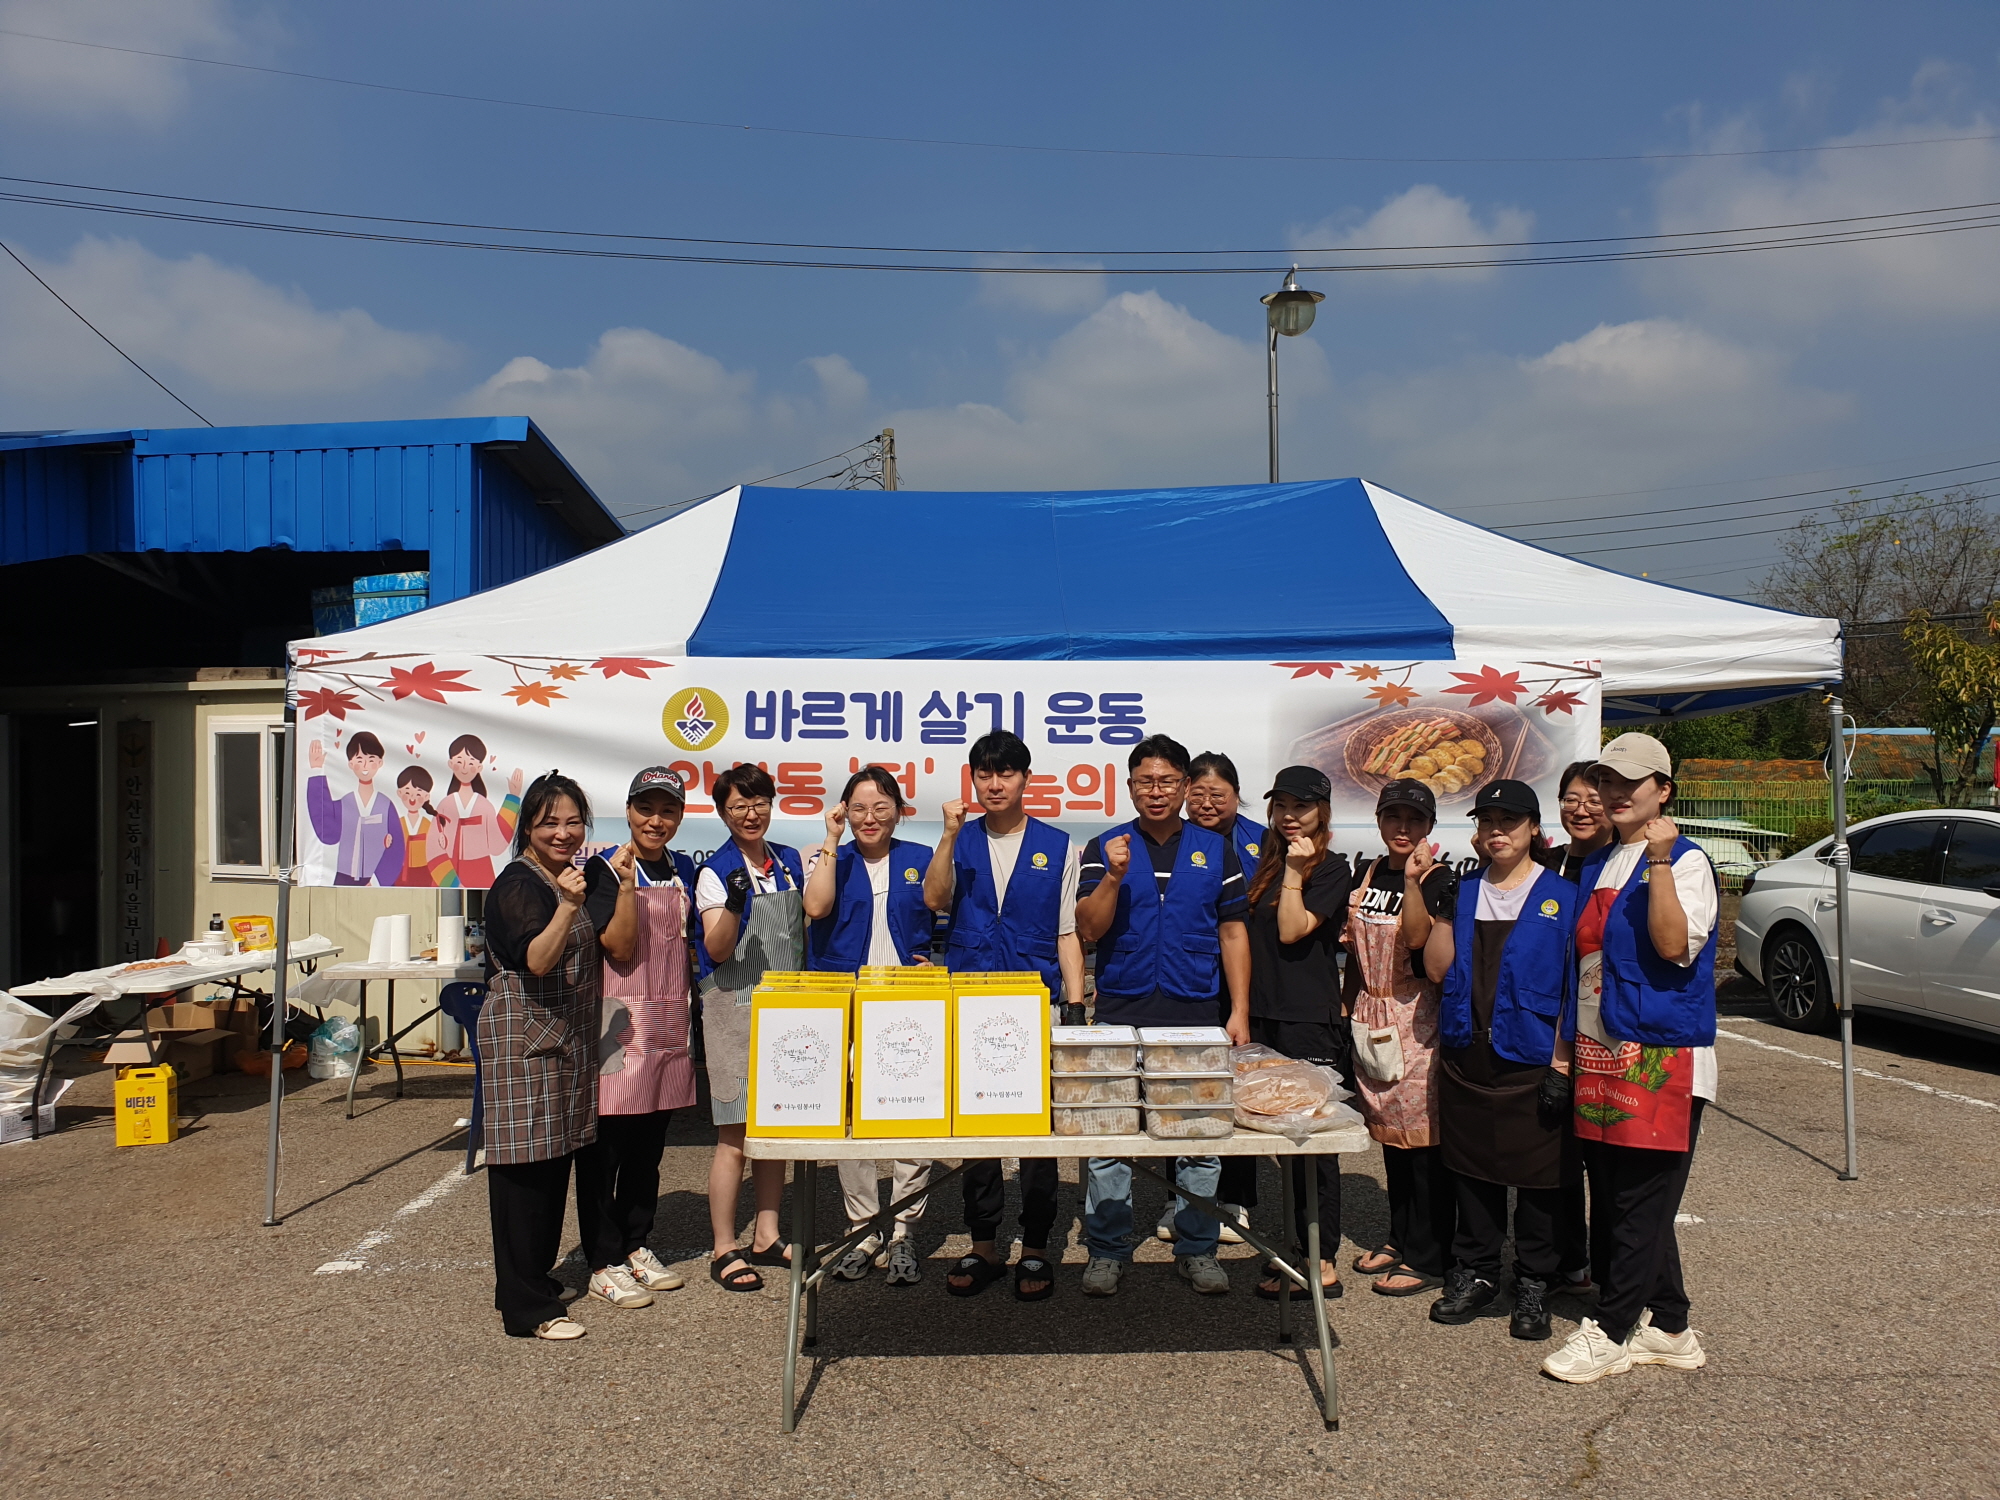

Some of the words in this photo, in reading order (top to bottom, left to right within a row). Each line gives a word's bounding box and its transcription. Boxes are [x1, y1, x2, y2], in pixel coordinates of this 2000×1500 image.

[745, 689, 903, 743] 바르게
[919, 689, 1024, 744] 살기
[1044, 691, 1147, 745] 운동
